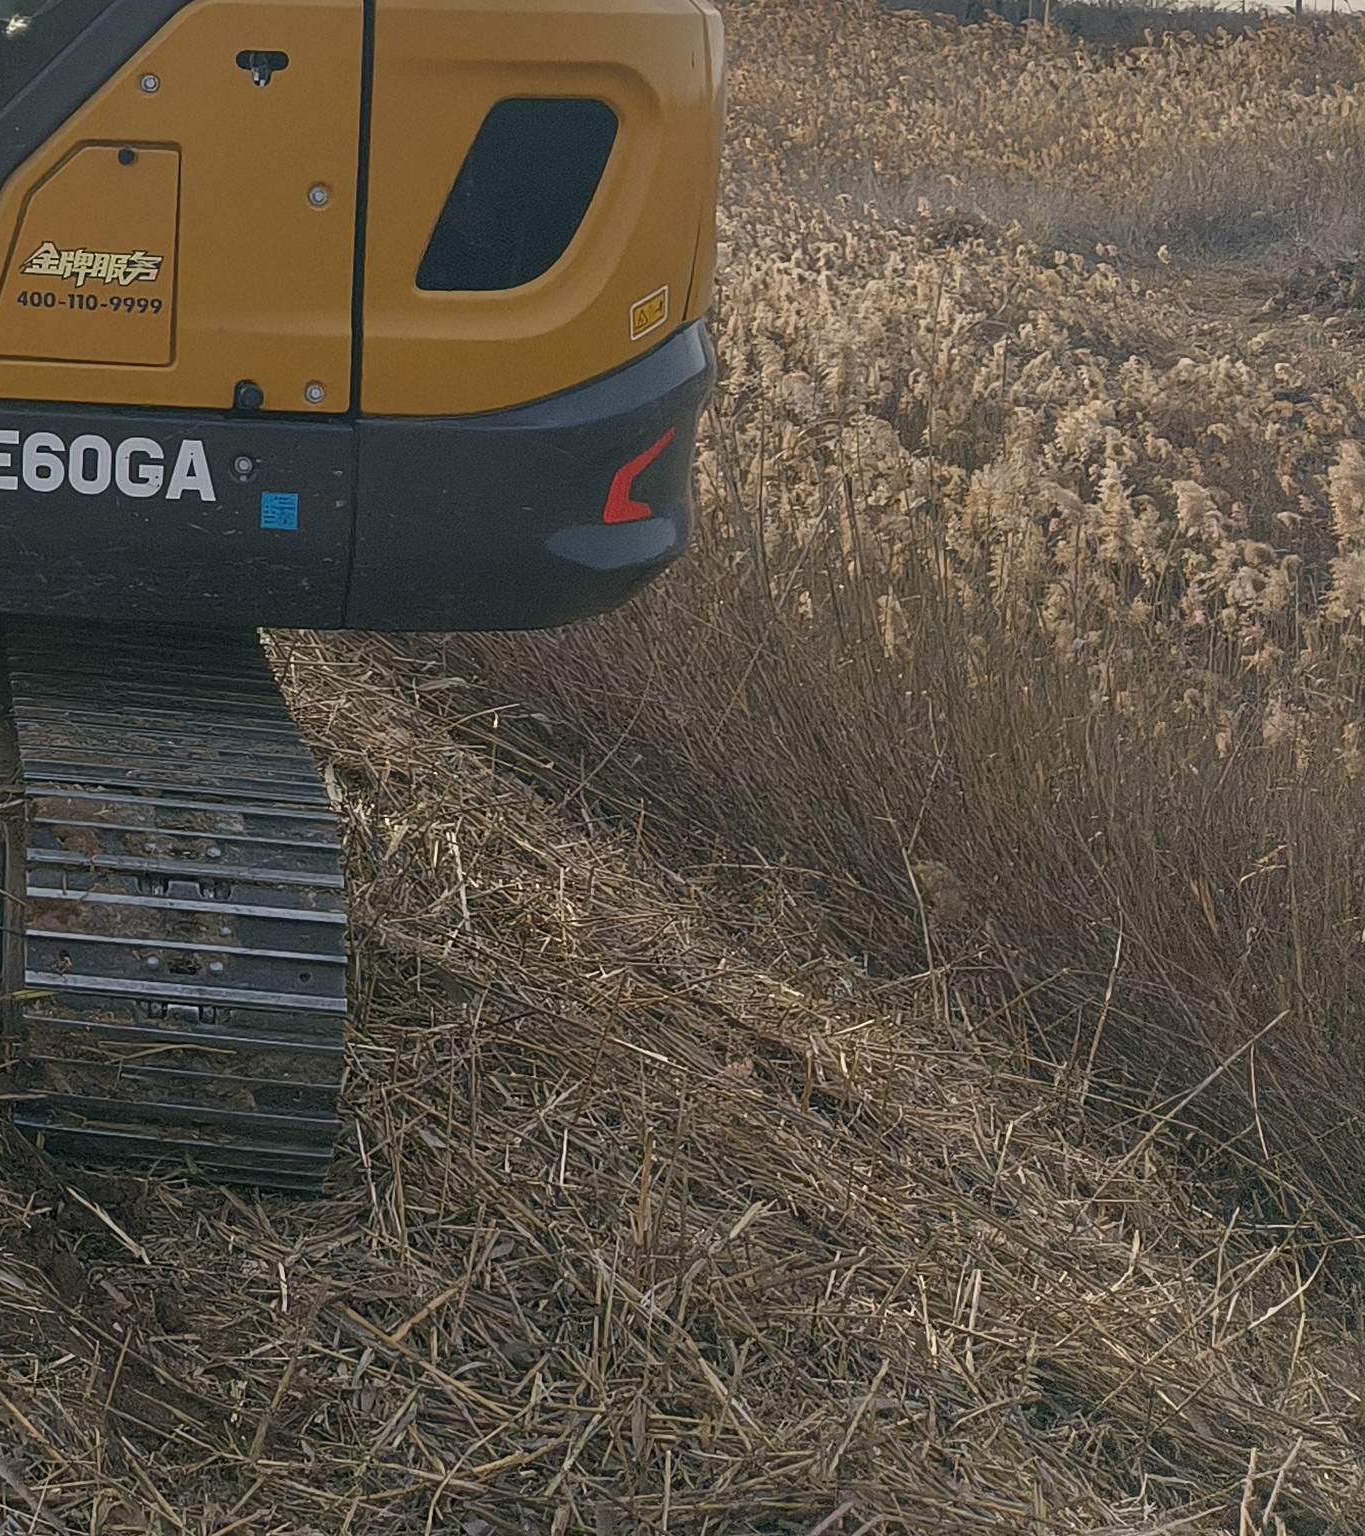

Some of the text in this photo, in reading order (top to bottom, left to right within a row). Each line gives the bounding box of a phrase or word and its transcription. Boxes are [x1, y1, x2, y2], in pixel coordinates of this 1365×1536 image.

[20, 241, 165, 288] 金牌服务
[17, 291, 163, 314] 400-110-9999
